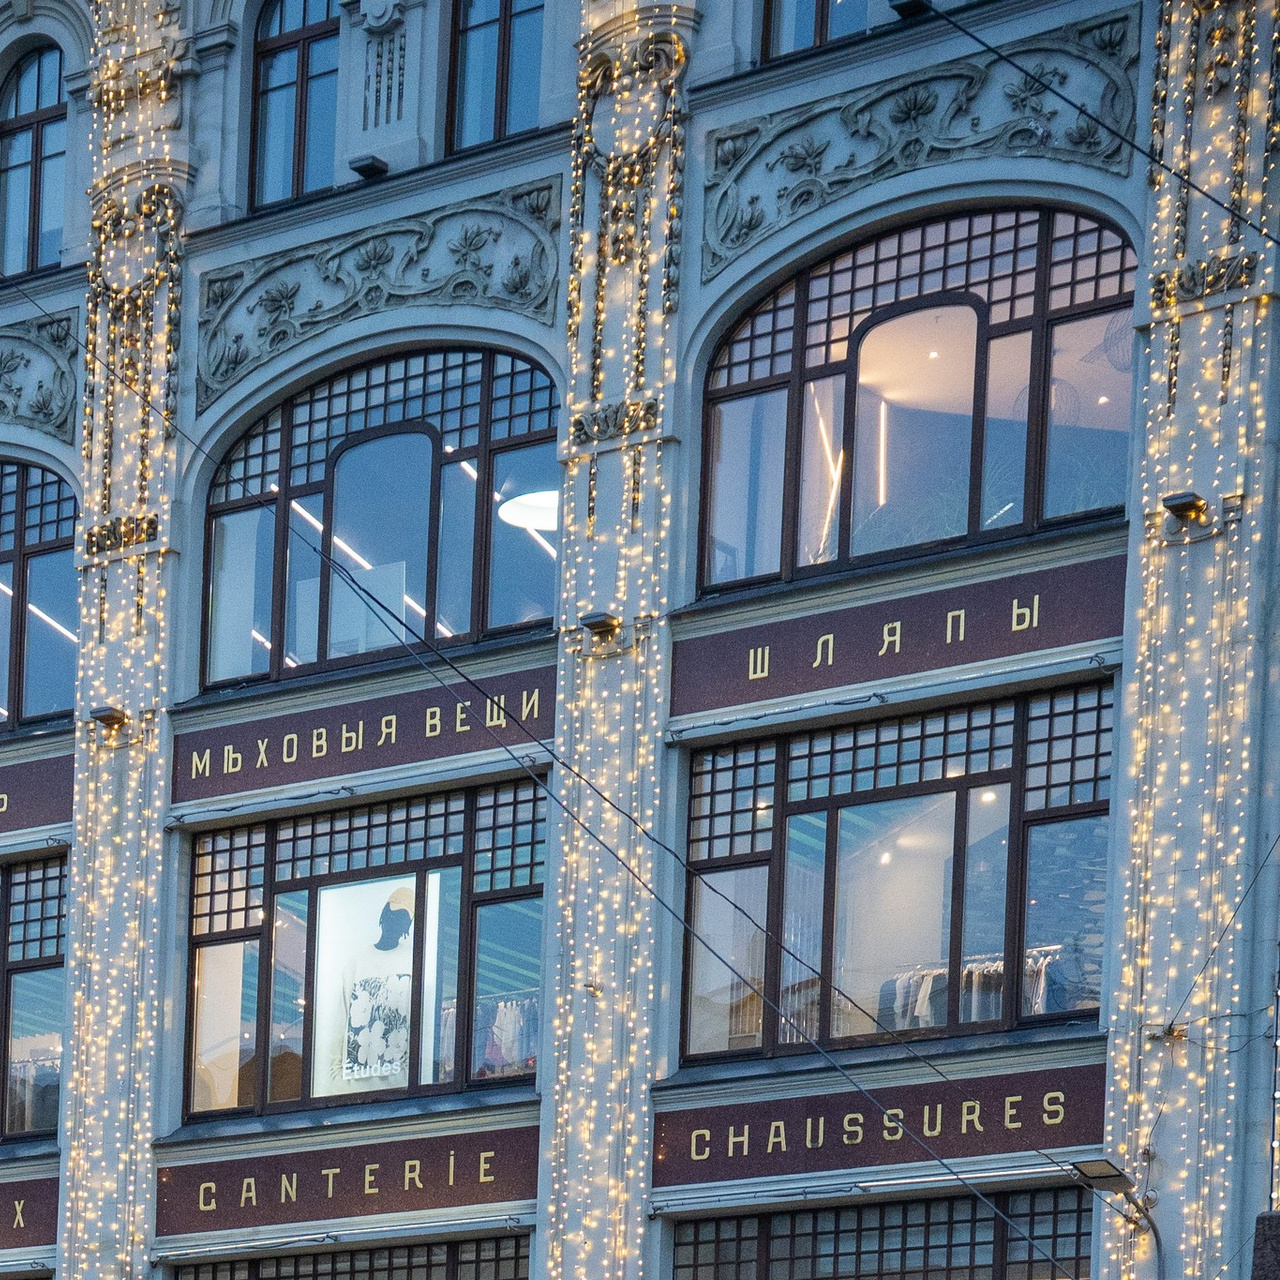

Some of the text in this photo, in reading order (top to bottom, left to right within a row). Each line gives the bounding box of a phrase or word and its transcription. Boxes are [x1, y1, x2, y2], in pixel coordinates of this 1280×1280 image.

[748, 595, 1039, 680] ШЛЯПЫ
[425, 688, 540, 738] ВЕЩИ
[342, 1059, 402, 1080] Études
[690, 1091, 1066, 1161] CHAUSSURES
[199, 1150, 495, 1211] GANTERIE
